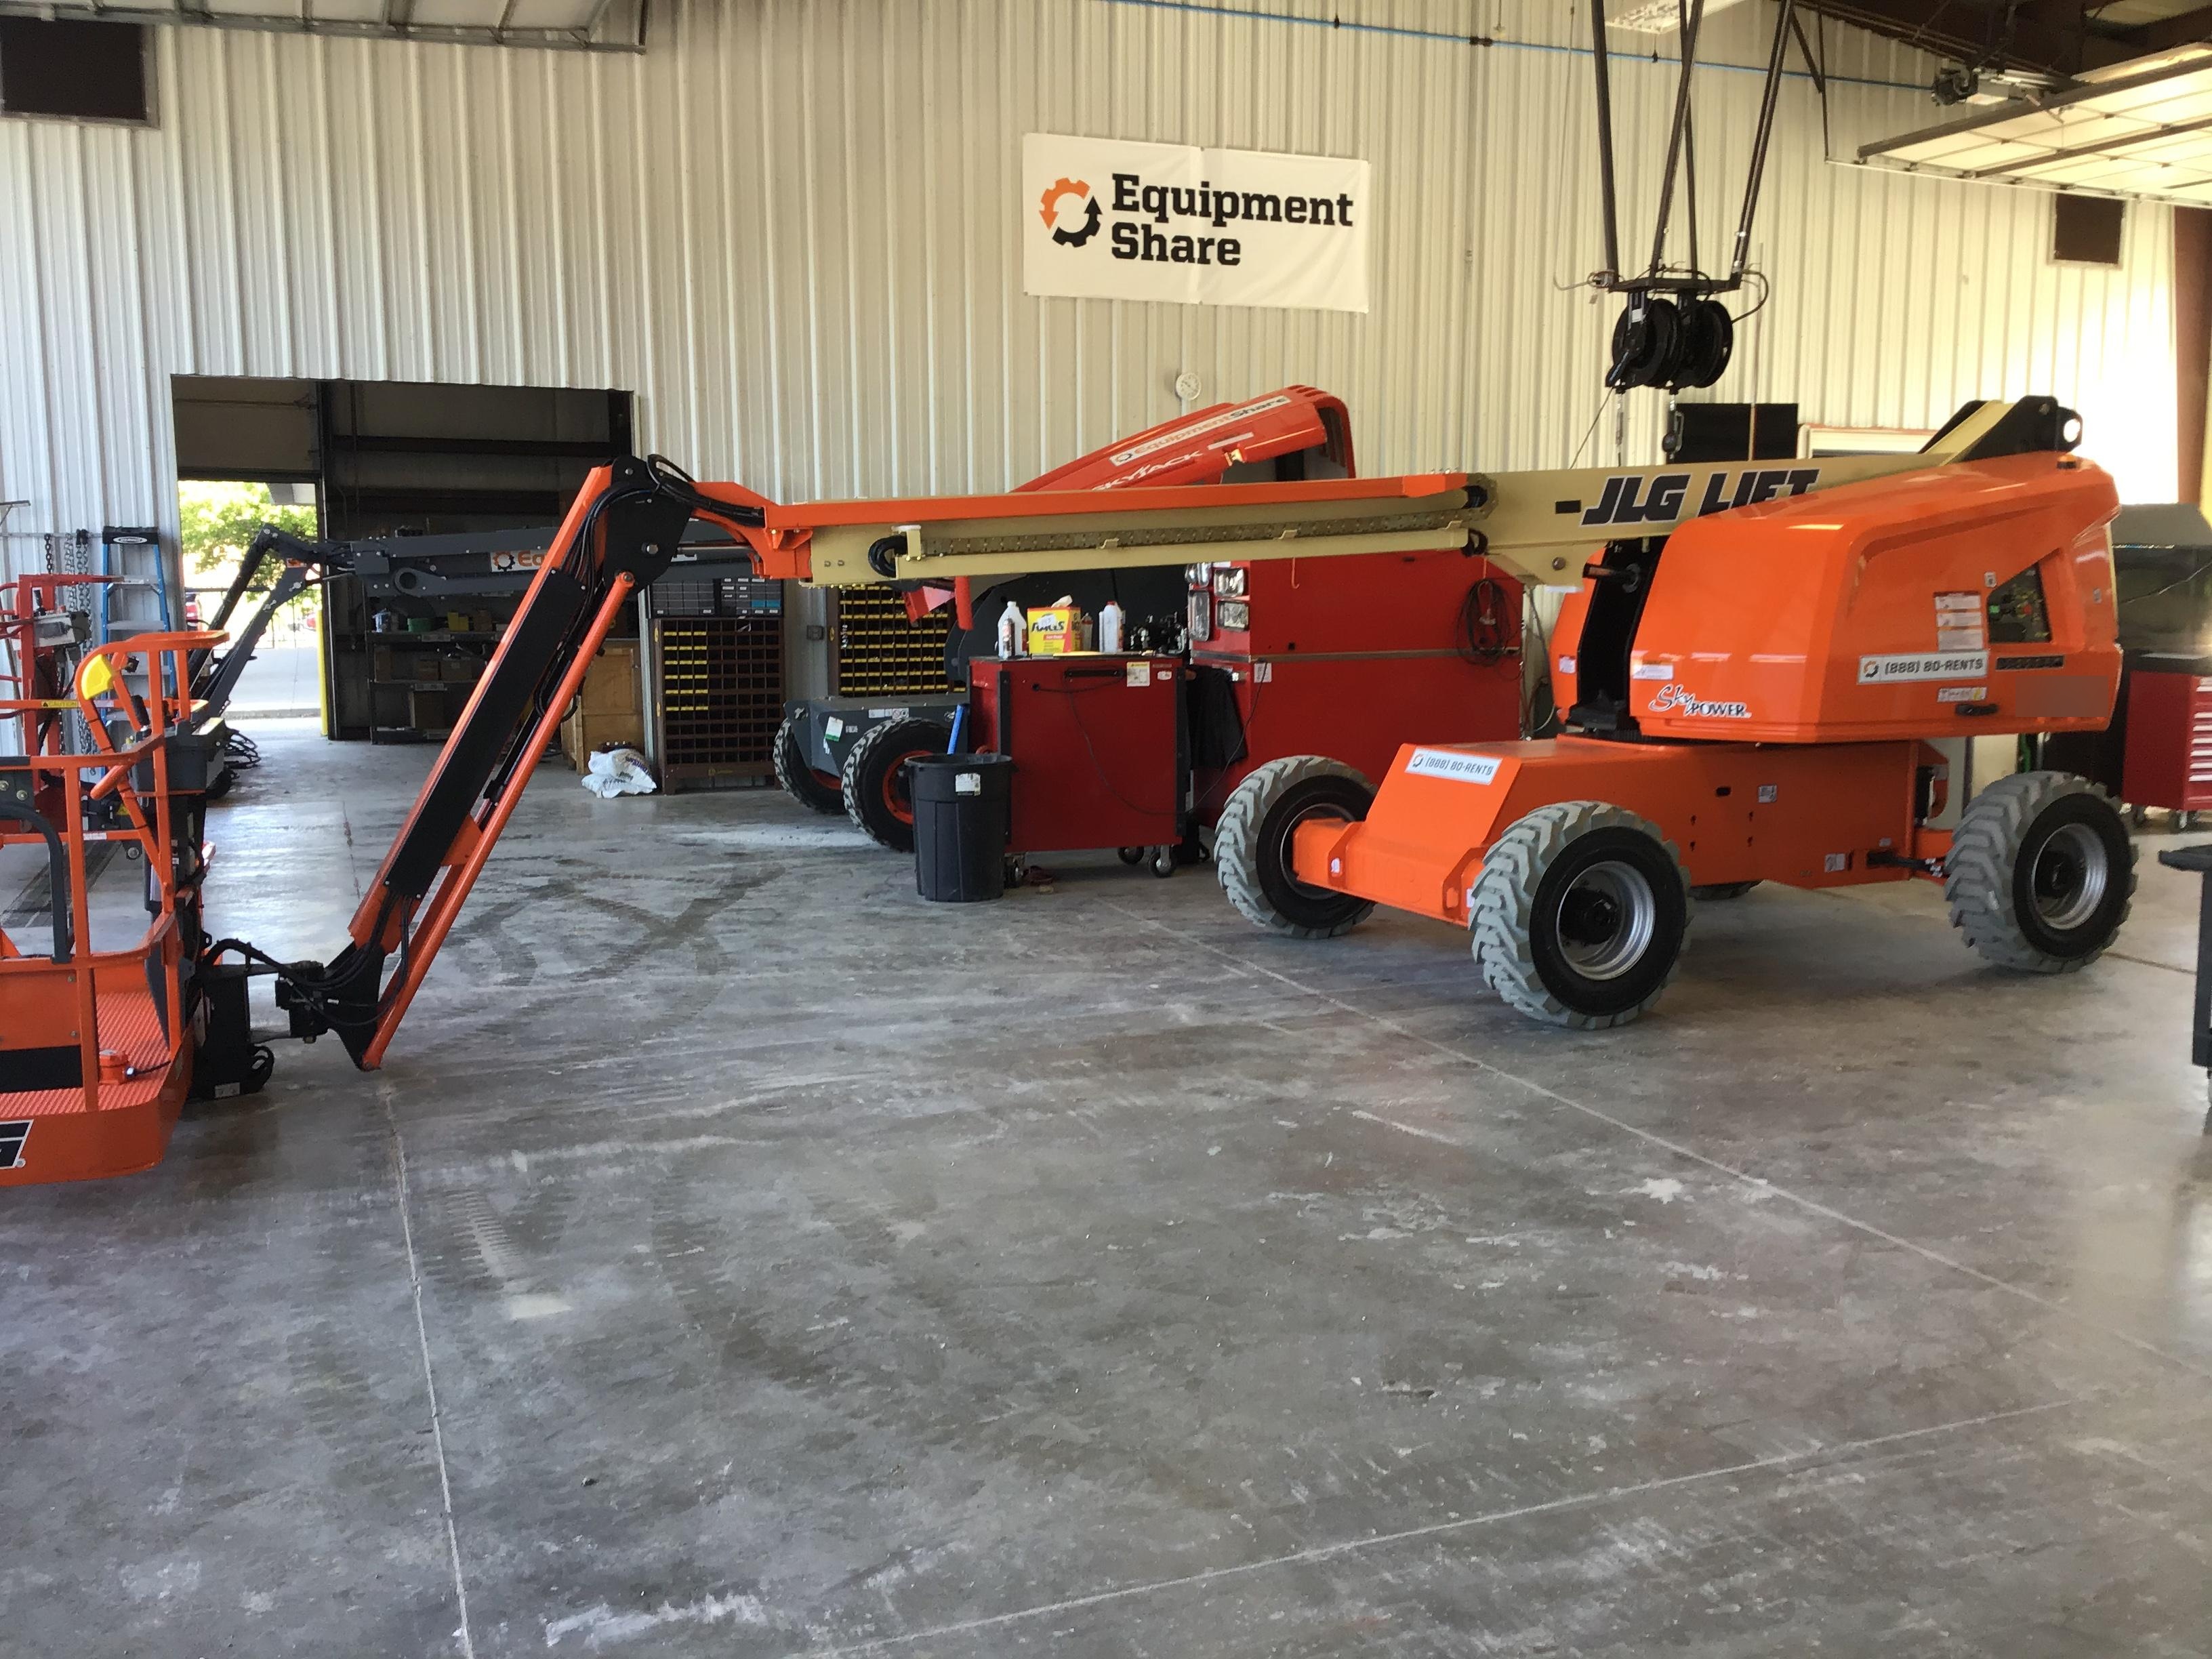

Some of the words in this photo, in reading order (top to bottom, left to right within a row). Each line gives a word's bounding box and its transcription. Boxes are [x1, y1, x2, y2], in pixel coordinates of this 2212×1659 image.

[1111, 172, 1353, 227] Equipment
[1111, 222, 1242, 266] Share
[1580, 474, 1692, 526] JLG
[1696, 468, 1821, 518] LIFT
[1884, 659, 1921, 675] (888)
[1425, 756, 1451, 771] (888)
